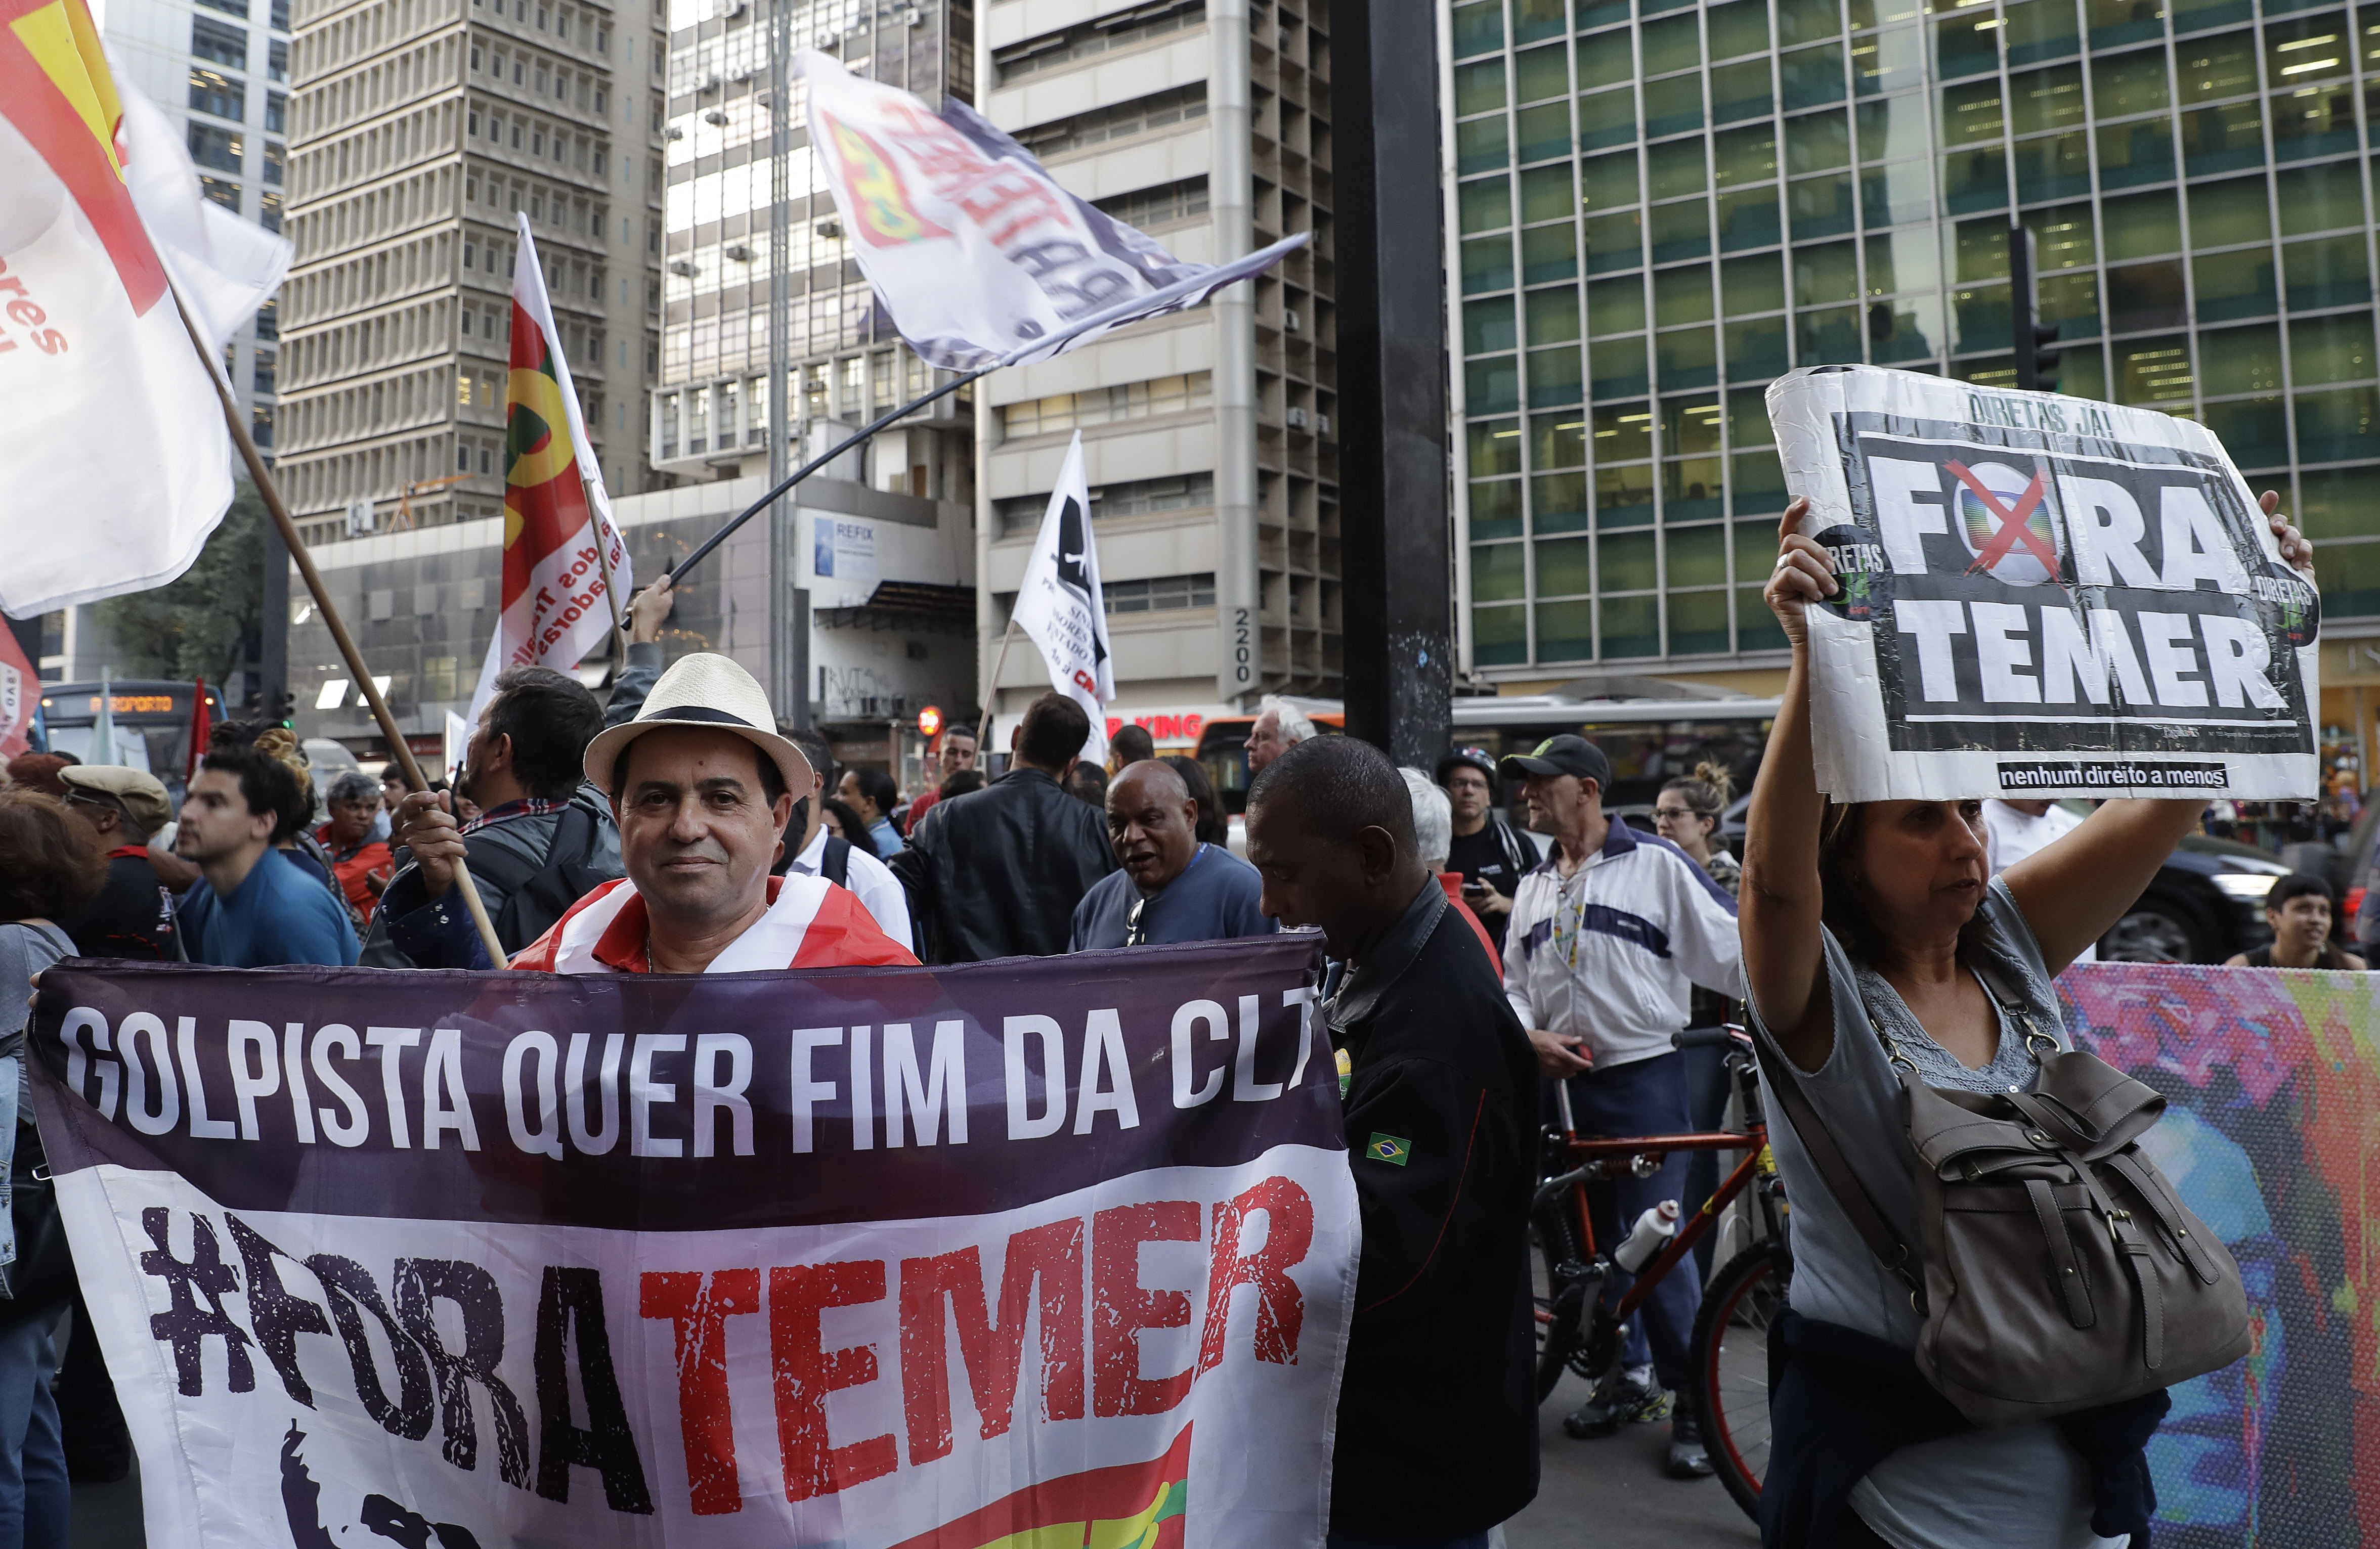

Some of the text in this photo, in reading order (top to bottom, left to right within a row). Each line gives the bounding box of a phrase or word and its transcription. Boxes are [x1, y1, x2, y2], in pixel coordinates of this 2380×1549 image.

[1967, 392, 2067, 434] DIRETAS
[1825, 544, 1885, 575] RETAS
[2254, 575, 2313, 606] DIRETAS
[1236, 608, 1249, 682] 2200
[1892, 599, 2290, 709] TEMER
[2000, 765, 2225, 786] nenhum direito a menos
[59, 1006, 481, 1152] GOLPISTA
[502, 1032, 755, 1161] QUER
[791, 1020, 969, 1154] FIM
[1003, 1008, 1141, 1140] DA
